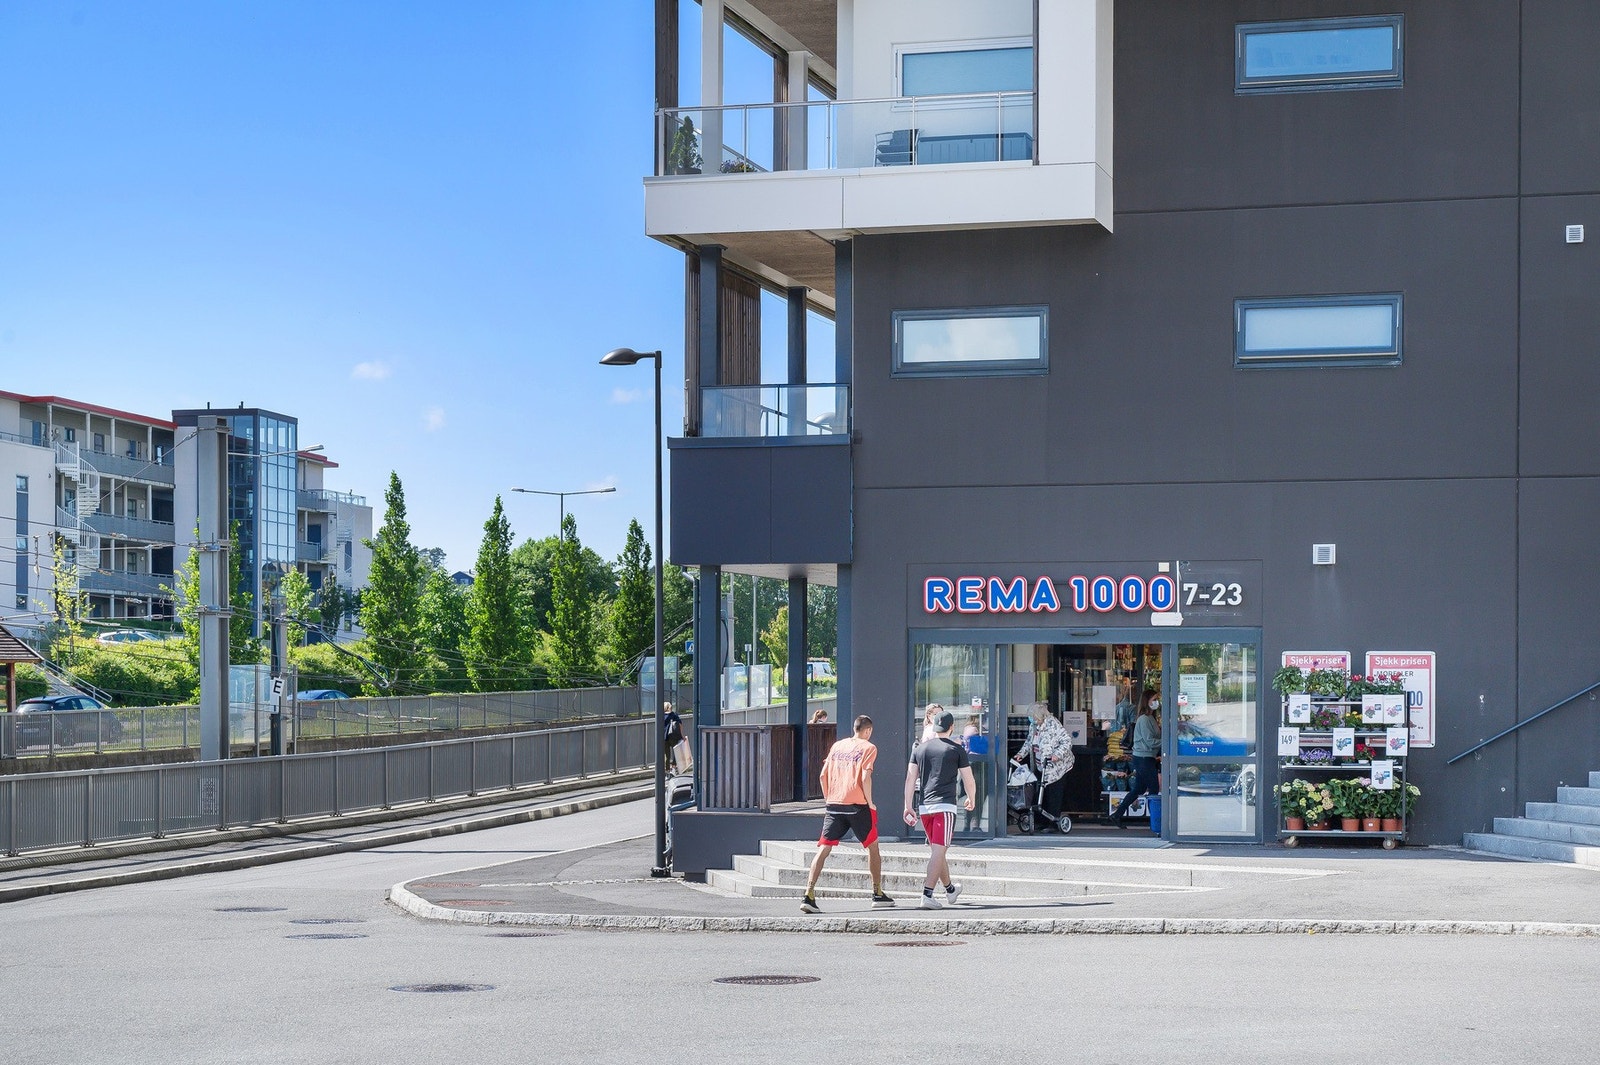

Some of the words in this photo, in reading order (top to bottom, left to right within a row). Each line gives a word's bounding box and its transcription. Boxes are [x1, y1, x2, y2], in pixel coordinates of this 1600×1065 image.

[923, 575, 1061, 614] REMA
[1068, 575, 1176, 613] 1000
[1183, 582, 1243, 606] 7-23
[1291, 656, 1314, 666] Sjekk
[1375, 656, 1398, 666] Sjekk
[1400, 656, 1428, 666] prisen
[273, 680, 283, 694] E
[1281, 735, 1293, 745] 149
